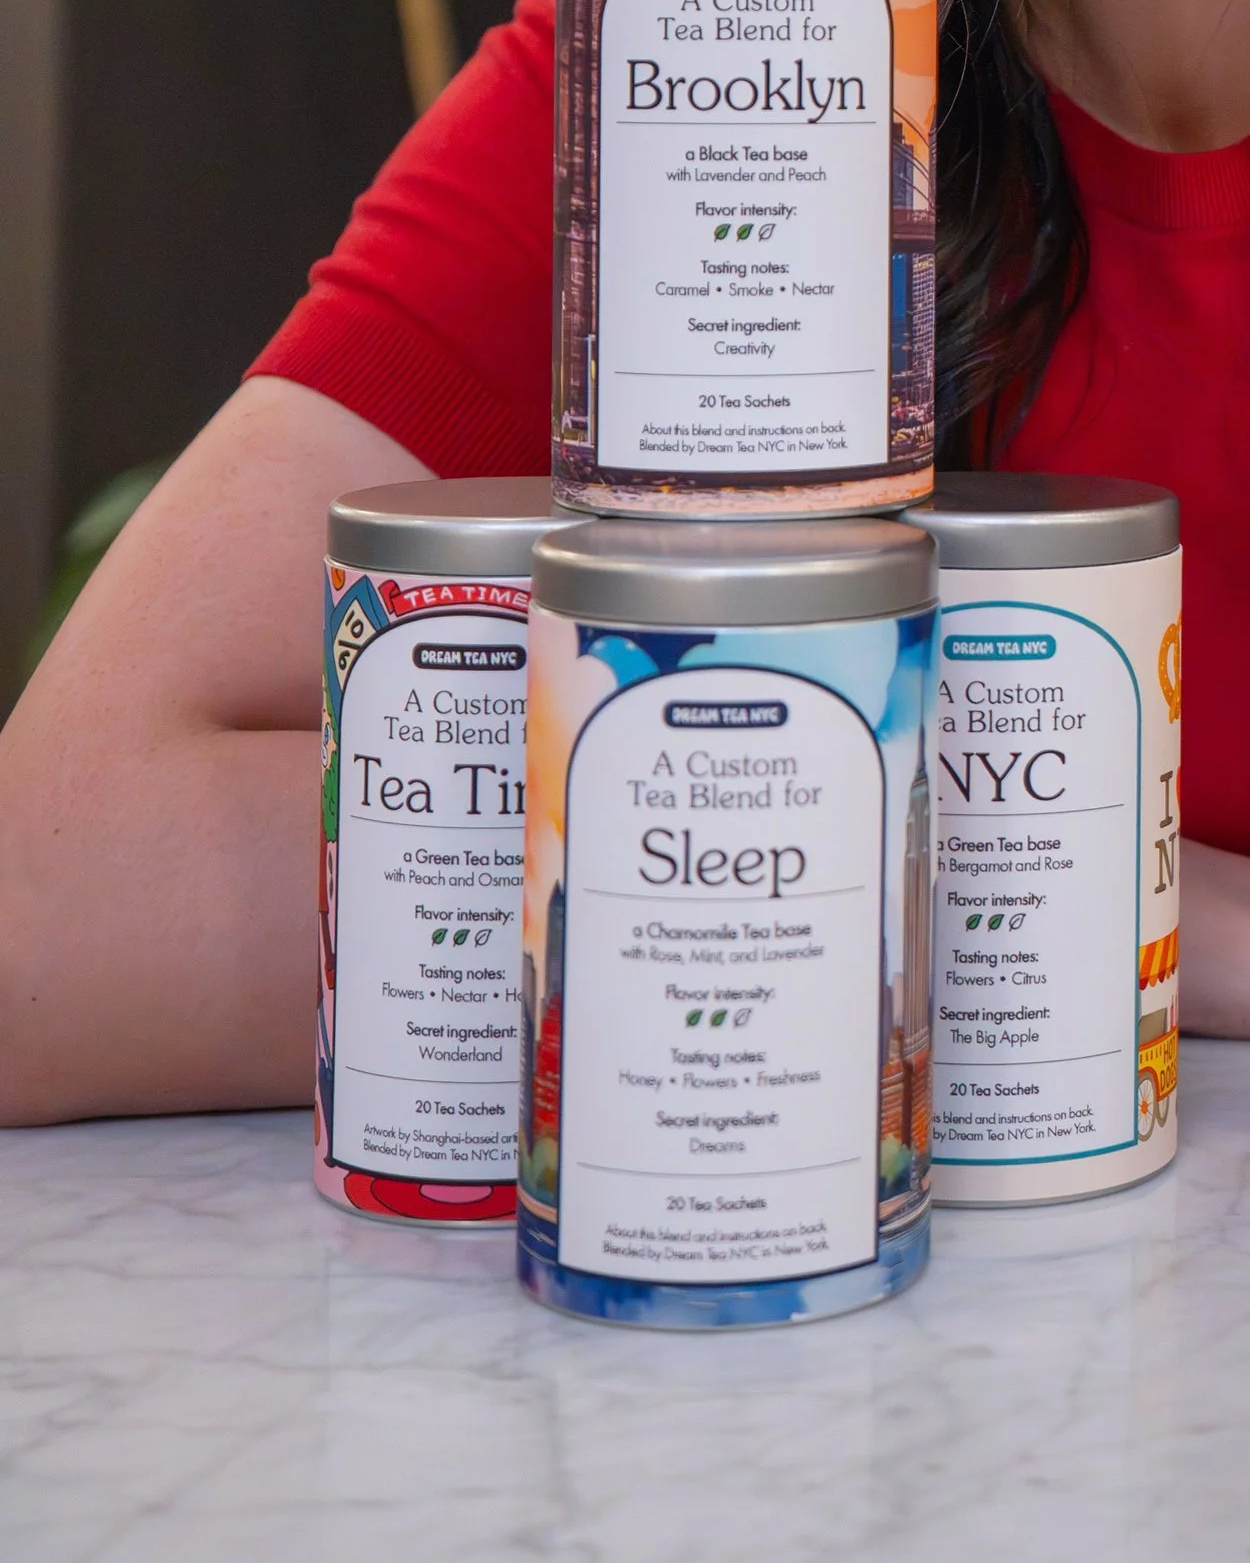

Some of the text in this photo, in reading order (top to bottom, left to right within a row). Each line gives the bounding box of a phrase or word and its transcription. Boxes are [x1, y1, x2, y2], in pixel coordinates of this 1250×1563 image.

[657, 17, 836, 41] Tea Blend for
[626, 59, 865, 123] Brooklyn
[685, 145, 808, 161] a Black Tea base
[666, 166, 826, 181] with Lavender and Peach
[696, 201, 796, 220] Flavor intensity:
[701, 260, 789, 278] Tasting notes:
[655, 281, 835, 296] Caramel Smoke Nectar
[688, 317, 800, 336] Secret ingredient:
[714, 341, 775, 358] Creativity
[699, 394, 790, 408] 20 Tea Sachets
[642, 422, 672, 435] About
[674, 424, 689, 435] this
[692, 424, 722, 436] blend
[724, 424, 746, 436] and
[748, 425, 803, 435] instructions
[805, 426, 818, 434] on
[640, 439, 679, 452] Blended
[681, 440, 695, 456] by
[698, 441, 733, 452] Dream
[736, 441, 755, 453] Tea
[758, 440, 784, 452] NYC
[787, 441, 796, 452] in
[799, 440, 824, 451] New
[403, 586, 529, 608] TEA TIME
[421, 650, 516, 665] DREAM TEA NYC
[953, 641, 1047, 655] DREAM TEA NYC
[404, 689, 423, 713] A
[965, 681, 1064, 705] Custom
[672, 707, 779, 724] DREAM TEA NYC
[968, 709, 1041, 733] Blend
[1053, 707, 1086, 731] for
[384, 716, 424, 742] Tea
[435, 720, 509, 745] Blend
[653, 751, 797, 779] A Custom
[354, 754, 434, 813] Tea
[627, 780, 822, 810] Tea Blend for
[947, 835, 1061, 852] Green Tea base
[403, 849, 489, 866] a Green Tea
[639, 827, 806, 898] Sleep
[949, 857, 1012, 877] Bergamot
[1015, 856, 1040, 871] and
[1045, 857, 1073, 870] Rose
[384, 867, 474, 887] with Peach and
[948, 891, 1046, 909] Flavor intensity:
[415, 905, 514, 925] Flavor intensity:
[633, 922, 812, 941] a Chamomile Tea base
[952, 949, 1038, 968] Tasting notes:
[419, 964, 505, 984] Tasting notes:
[944, 970, 1046, 986] Flowers Citrus
[383, 982, 424, 1000] Flowers
[442, 988, 487, 1003] Nectar
[665, 984, 710, 1001] Flavor
[939, 1005, 1049, 1025] Secret ingredient:
[407, 1021, 517, 1042] Secret ingredient:
[950, 1028, 1039, 1048] The Big Apple
[419, 1046, 502, 1061] Wonderland
[671, 1048, 721, 1070] Tasting
[950, 1082, 1039, 1096] 20 Tea Sachets
[416, 1100, 505, 1116] 20 Tea Sachets
[943, 1111, 972, 1124] blend
[975, 1112, 996, 1124] and
[998, 1112, 1052, 1124] instructions
[1054, 1112, 1066, 1120] on
[656, 1111, 700, 1128] Secret
[364, 1124, 499, 1150] Artwork by Shanghai-based
[949, 1128, 983, 1141] Dream
[986, 1129, 1004, 1141] Tea
[1008, 1128, 1033, 1140] NYC
[1036, 1128, 1044, 1138] in
[1048, 1126, 1072, 1137] New
[364, 1139, 397, 1156] Blended
[399, 1144, 411, 1161] by
[414, 1146, 447, 1160] Dream
[450, 1149, 468, 1161] Tea
[472, 1149, 498, 1161] NYC
[501, 1149, 511, 1160] in
[667, 1196, 767, 1212] 20 Tea Sachets
